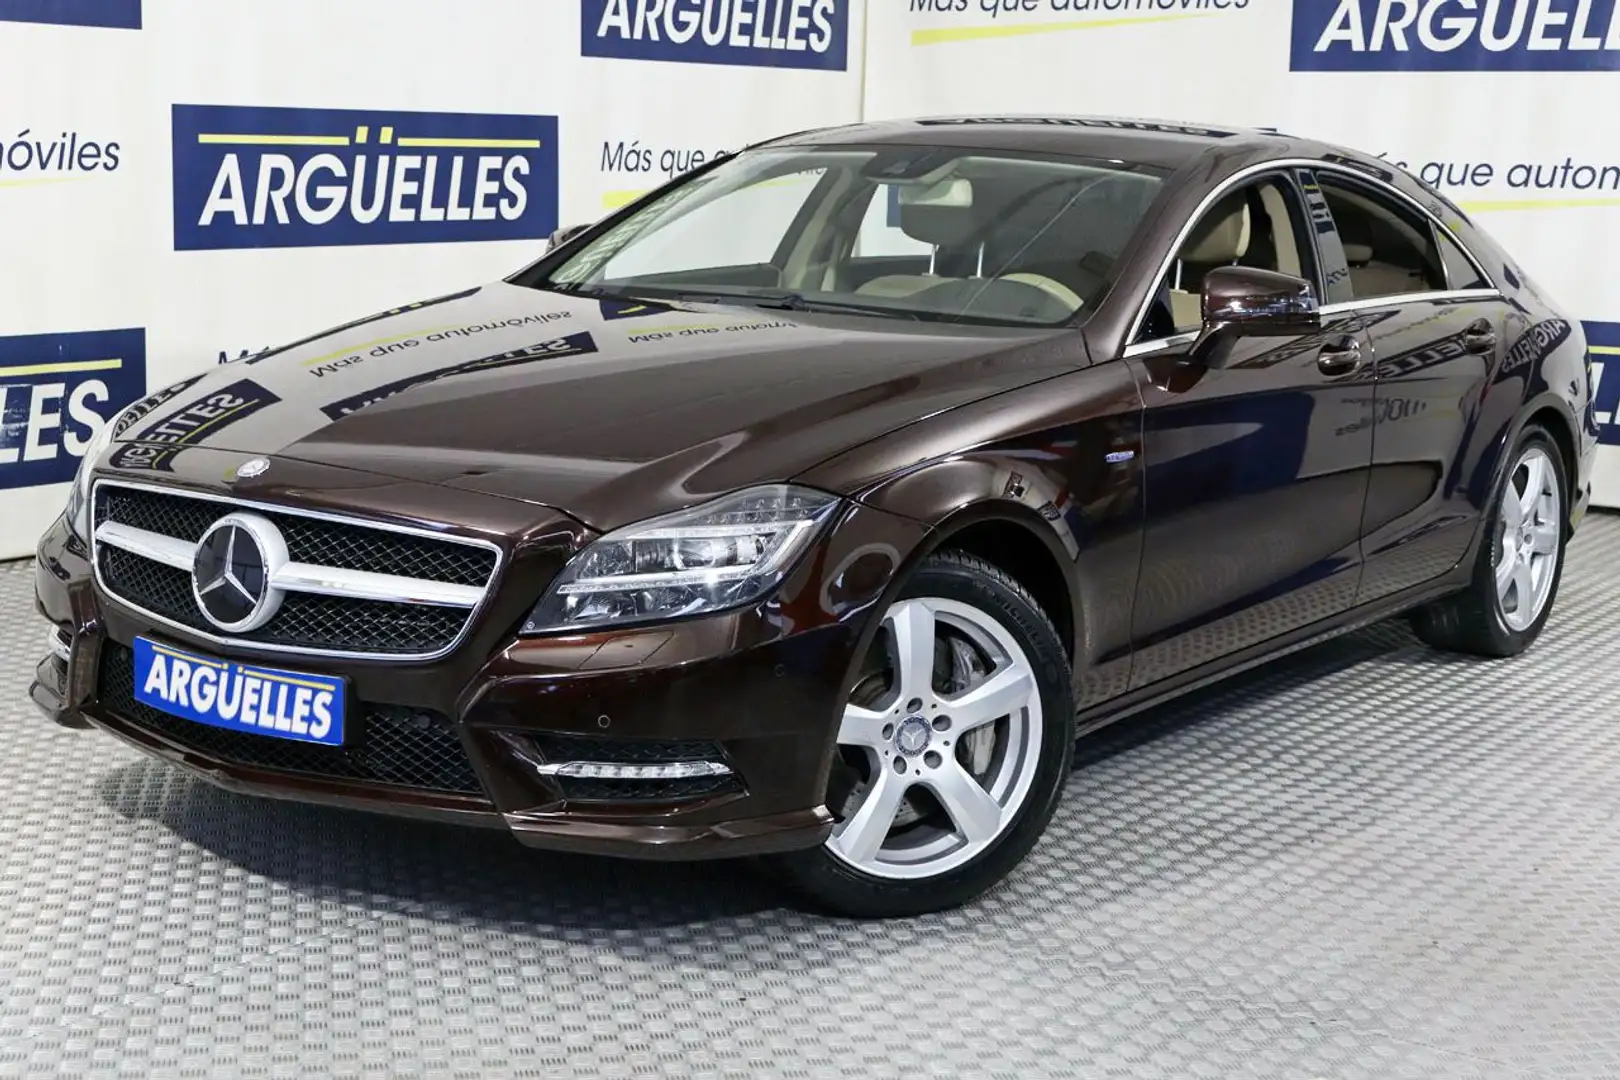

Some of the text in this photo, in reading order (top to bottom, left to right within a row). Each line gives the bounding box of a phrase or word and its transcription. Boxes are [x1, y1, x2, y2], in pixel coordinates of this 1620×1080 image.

[0, 128, 120, 171] óviles
[600, 140, 652, 172] Más
[198, 126, 530, 226] ARGÜELLES
[1420, 161, 1494, 189] que
[143, 654, 334, 740] ARGÜELLES
